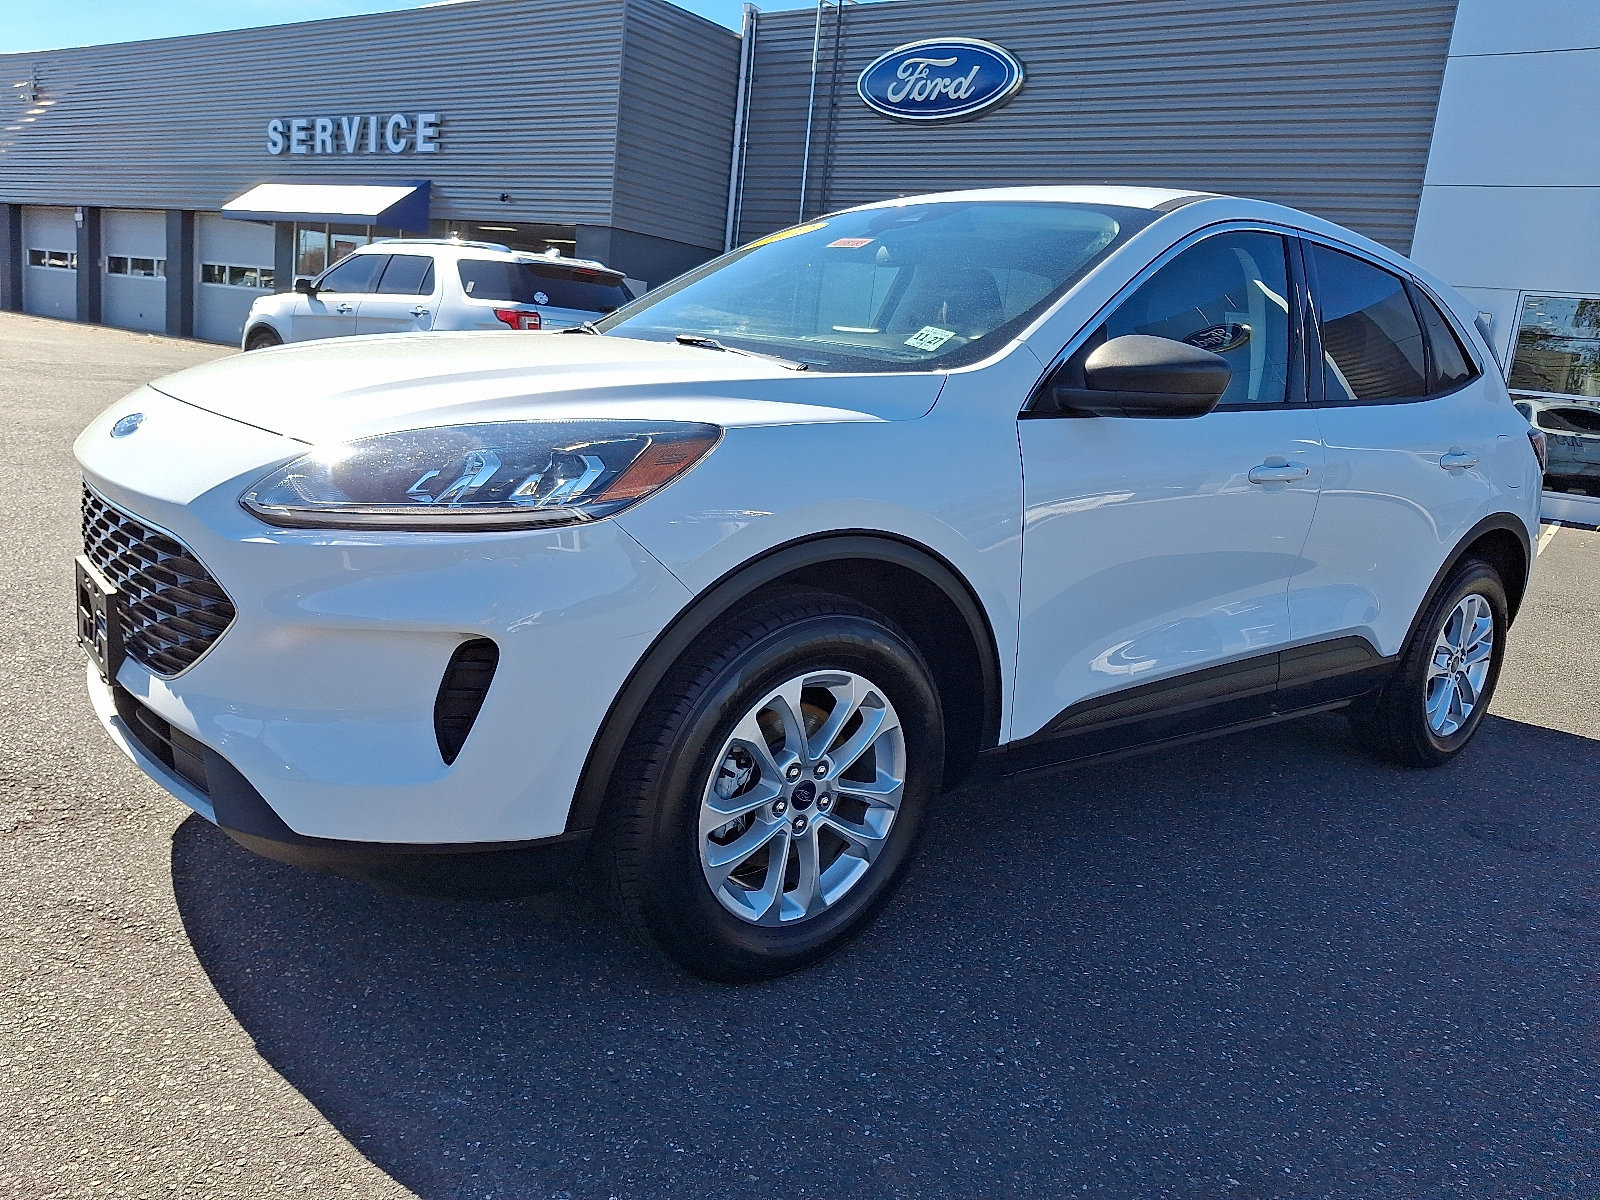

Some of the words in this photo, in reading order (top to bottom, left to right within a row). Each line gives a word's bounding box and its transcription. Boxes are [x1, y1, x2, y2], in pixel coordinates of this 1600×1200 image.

[887, 57, 980, 102] Ford
[267, 113, 436, 155] SERVICE
[914, 333, 930, 341] 11
[927, 336, 944, 346] 27
